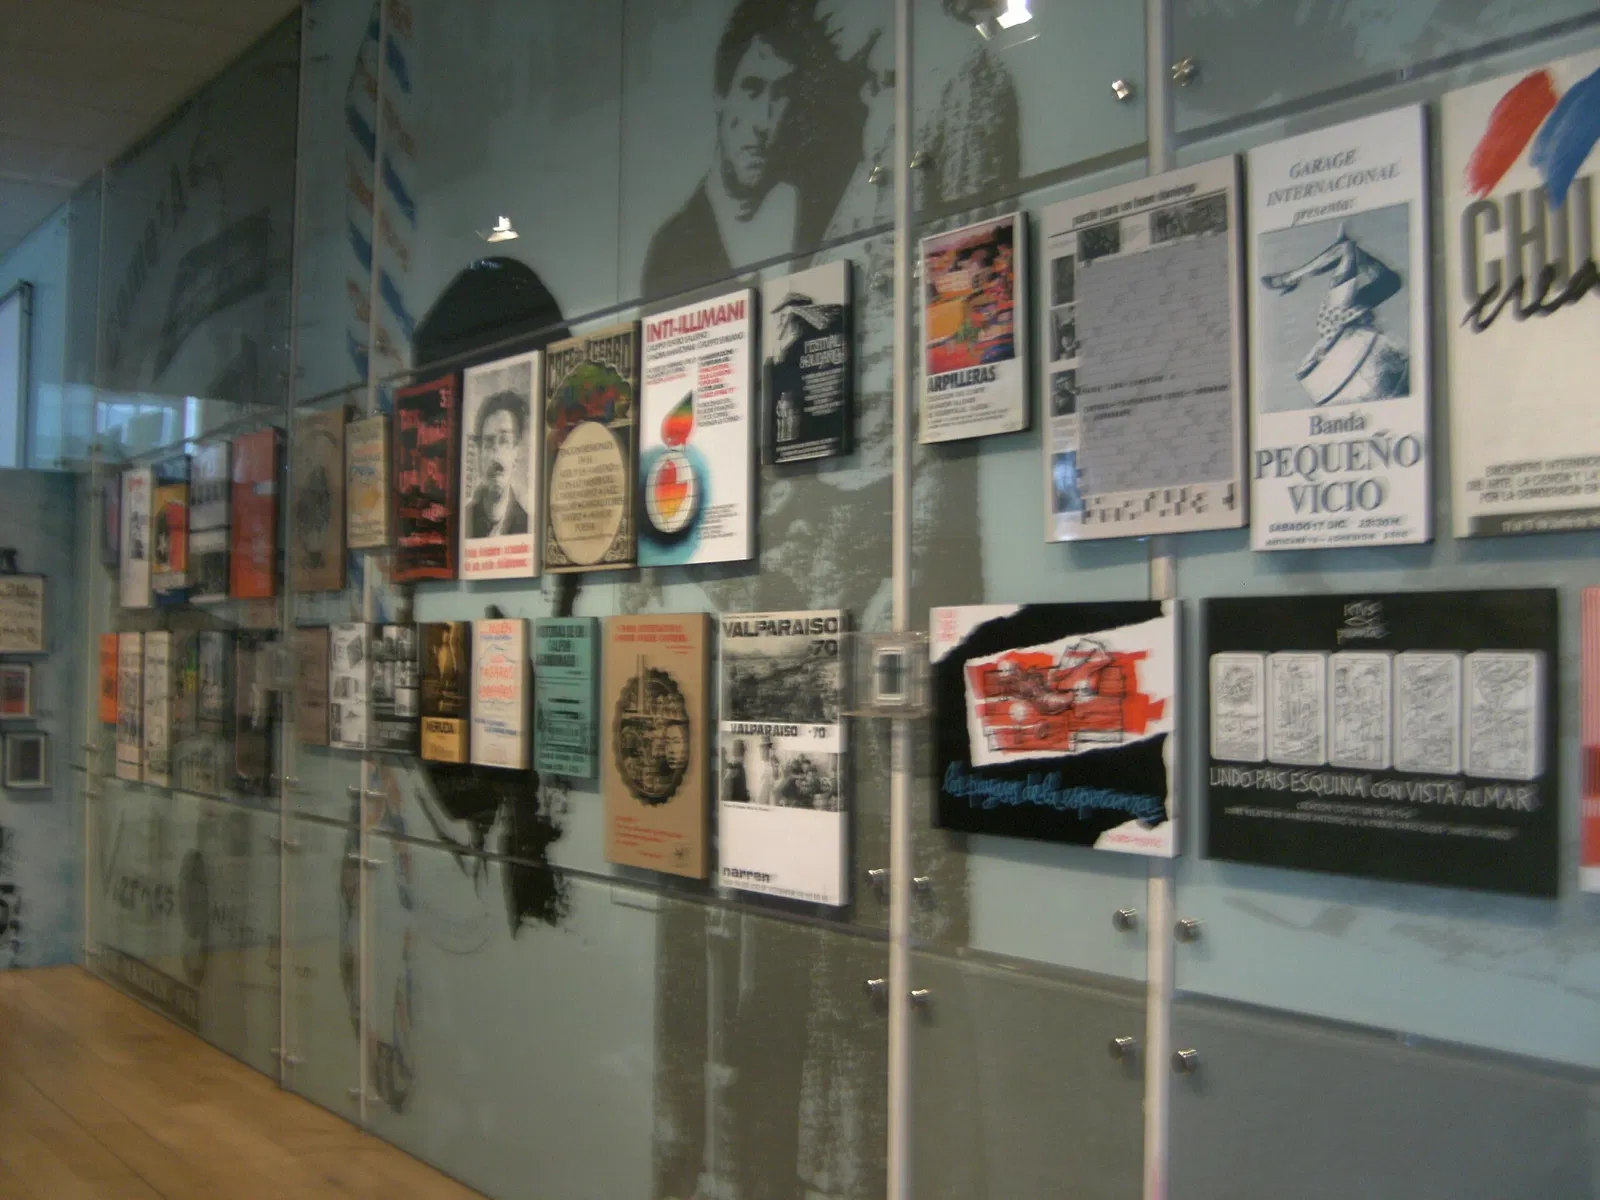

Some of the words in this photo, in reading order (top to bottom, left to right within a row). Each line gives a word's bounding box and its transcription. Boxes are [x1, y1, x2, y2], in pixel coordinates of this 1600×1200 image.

[1289, 149, 1358, 180] GARAGE
[1267, 162, 1400, 207] INTERNACIONAL
[646, 299, 744, 342] INTI-ILLIMANI
[927, 366, 996, 392] ARPILLERAS
[1309, 411, 1365, 436] Banda
[1253, 430, 1421, 481] PEQUEÑO
[1288, 479, 1383, 514] VICIO
[722, 617, 838, 638] VALPARAISO
[730, 723, 798, 738] VALPARAISO
[1210, 766, 1252, 788] LINDO
[1256, 769, 1288, 791] PAIS
[1290, 771, 1364, 798] ESQUINA
[1406, 781, 1457, 805] VISTA
[1484, 787, 1534, 812] MAR
[723, 866, 770, 883] narren
